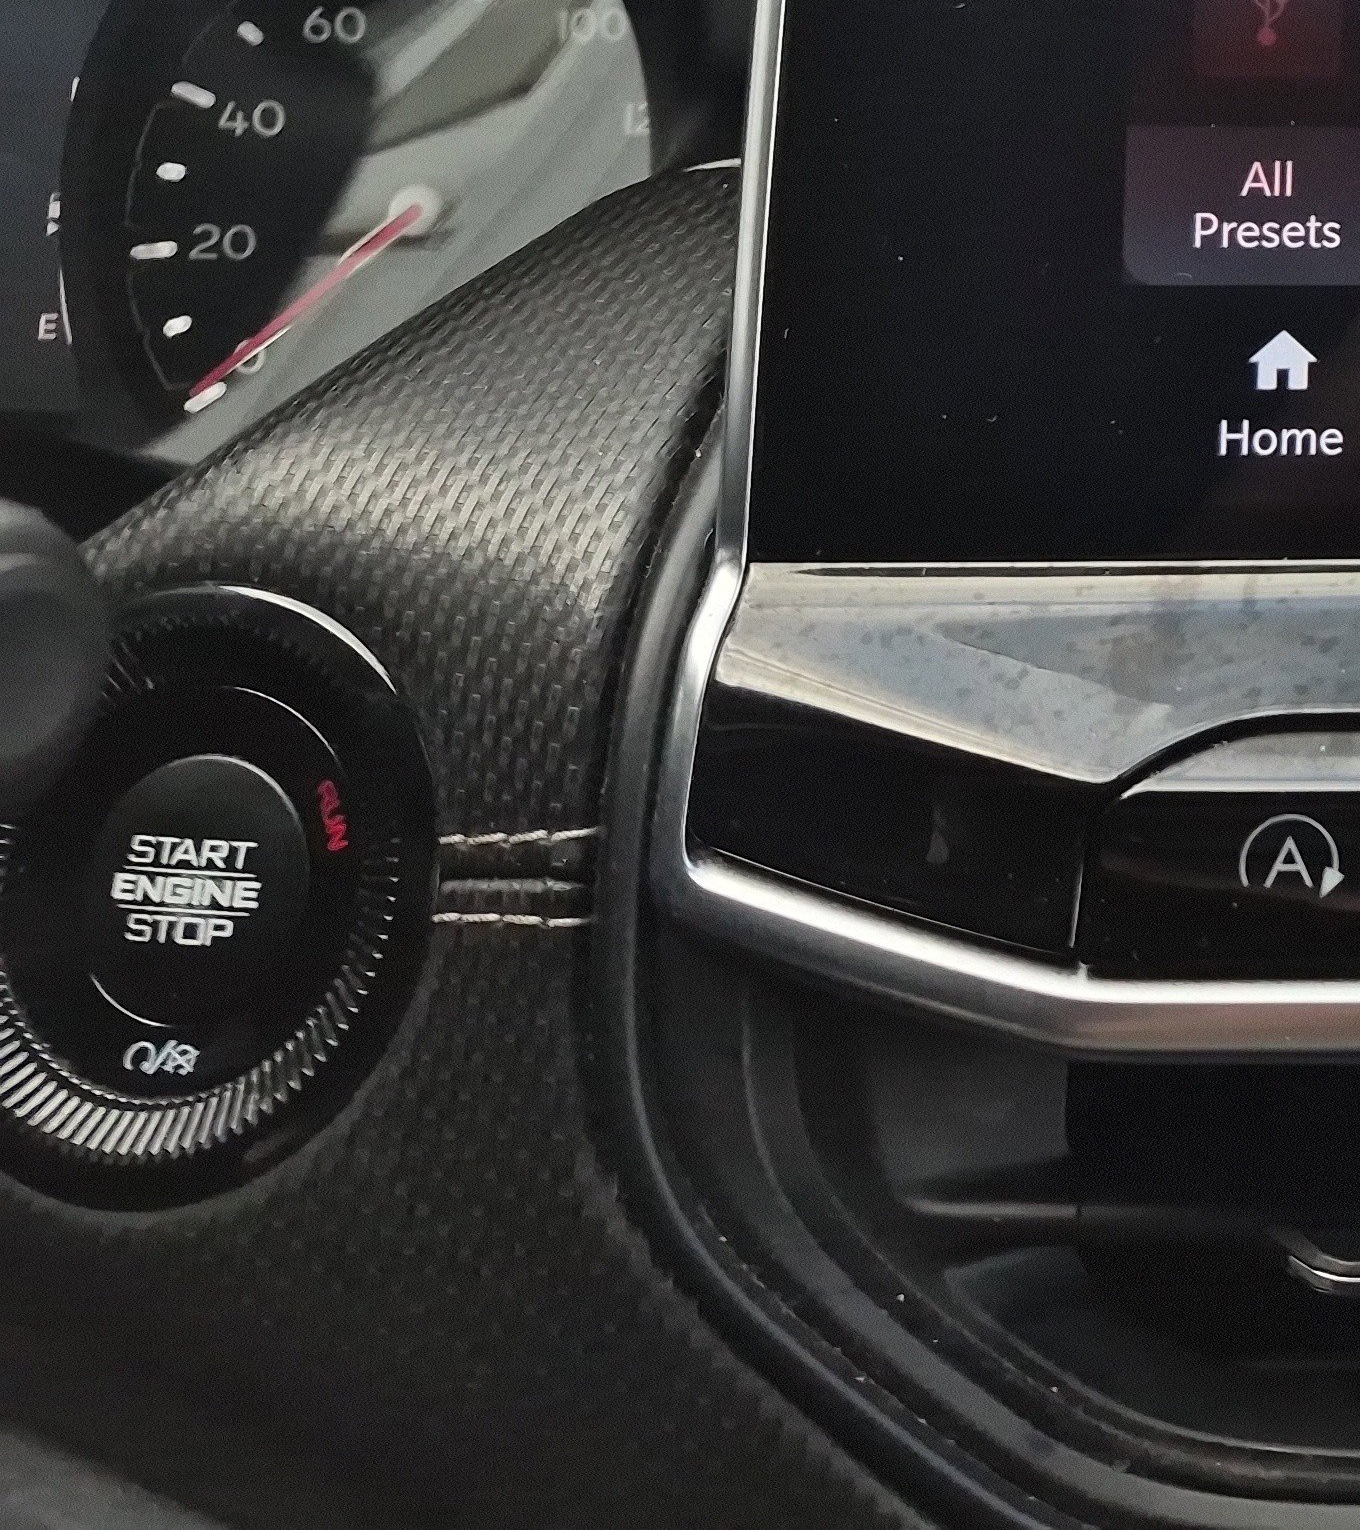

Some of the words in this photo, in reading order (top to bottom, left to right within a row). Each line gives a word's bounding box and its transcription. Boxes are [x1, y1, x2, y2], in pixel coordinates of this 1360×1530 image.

[303, 7, 369, 44] 60
[558, 7, 628, 43] 100
[218, 100, 286, 137] 40
[1240, 160, 1293, 197] All
[188, 223, 257, 260] 20
[1193, 212, 1341, 249] Presets
[37, 312, 59, 340] E
[1219, 419, 1344, 456] Home
[126, 833, 260, 870] START
[110, 871, 263, 909] ENGINE
[123, 912, 234, 947] STOP
